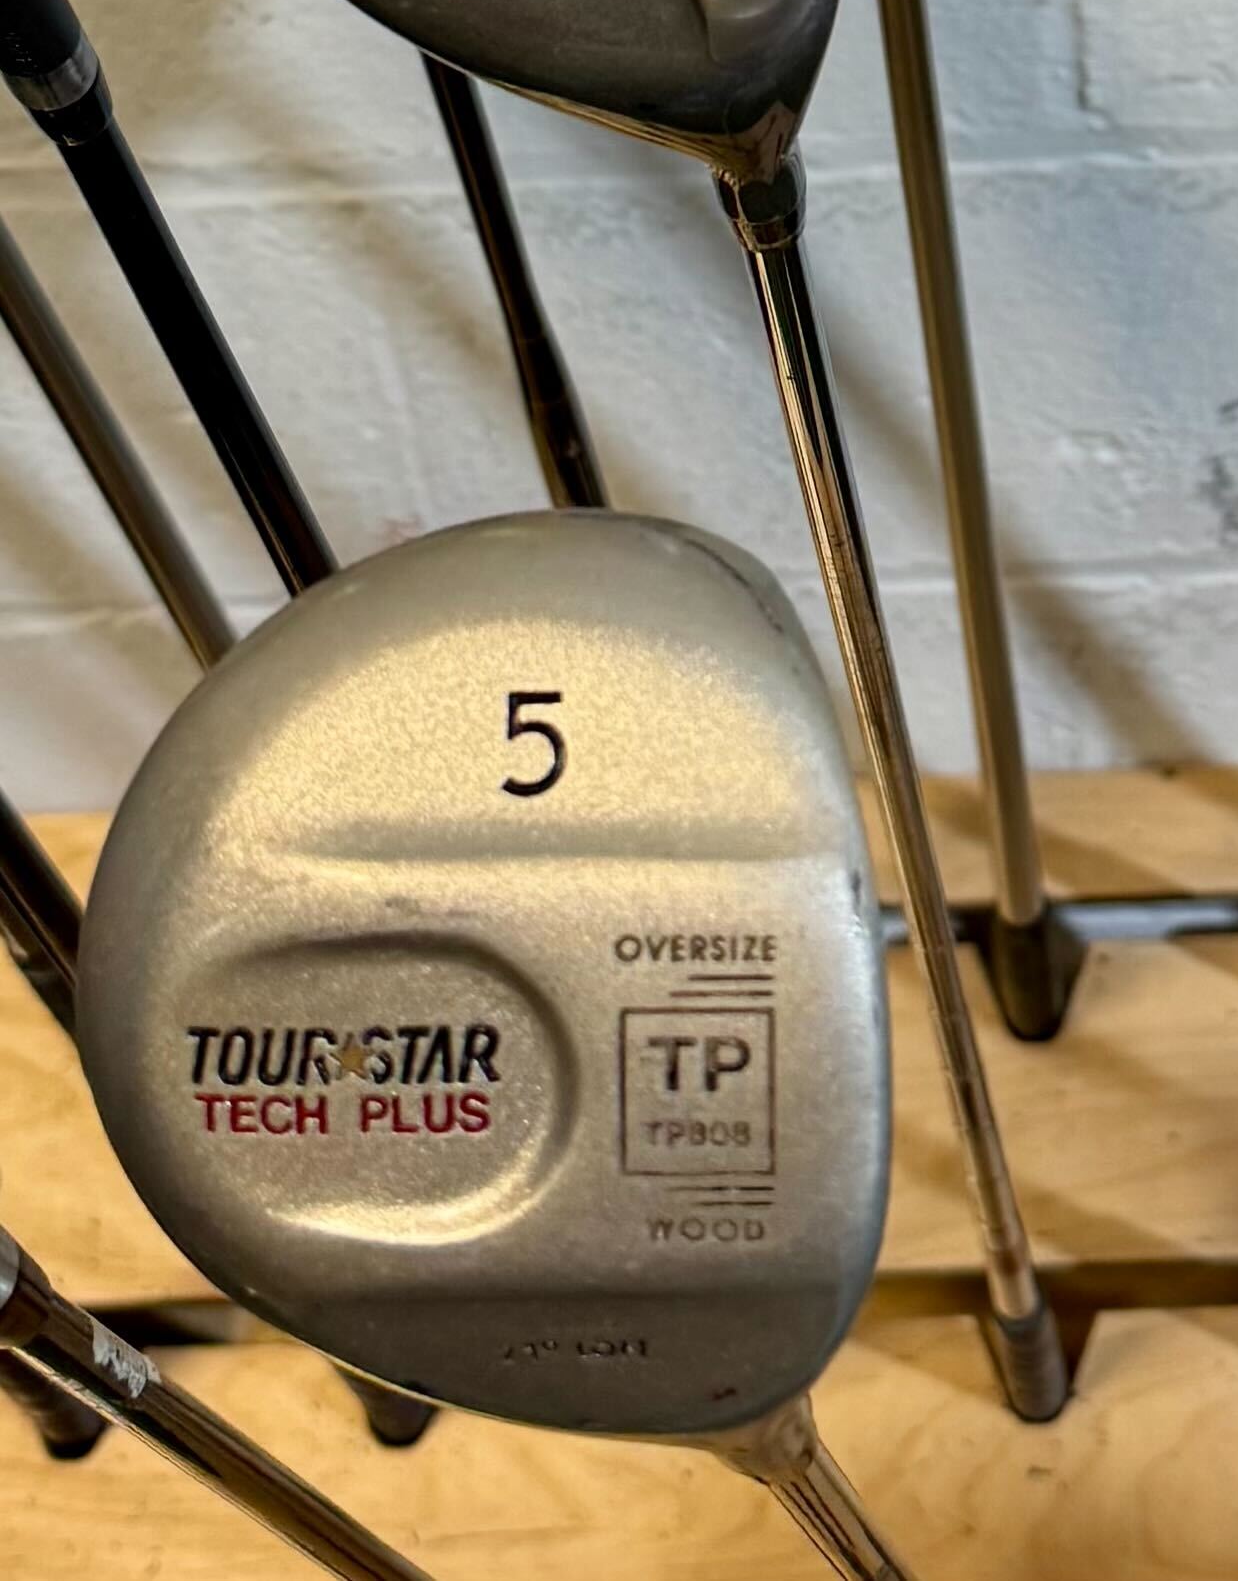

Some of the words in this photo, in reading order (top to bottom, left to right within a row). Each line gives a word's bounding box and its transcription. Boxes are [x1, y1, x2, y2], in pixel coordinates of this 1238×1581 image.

[502, 691, 568, 797] 5
[614, 933, 777, 962] OVERSIZE
[362, 1024, 501, 1085] STAR
[648, 1036, 751, 1093] TP
[194, 1092, 329, 1134] TECH
[359, 1092, 491, 1134] PLUS
[648, 1218, 766, 1242] WOOD
